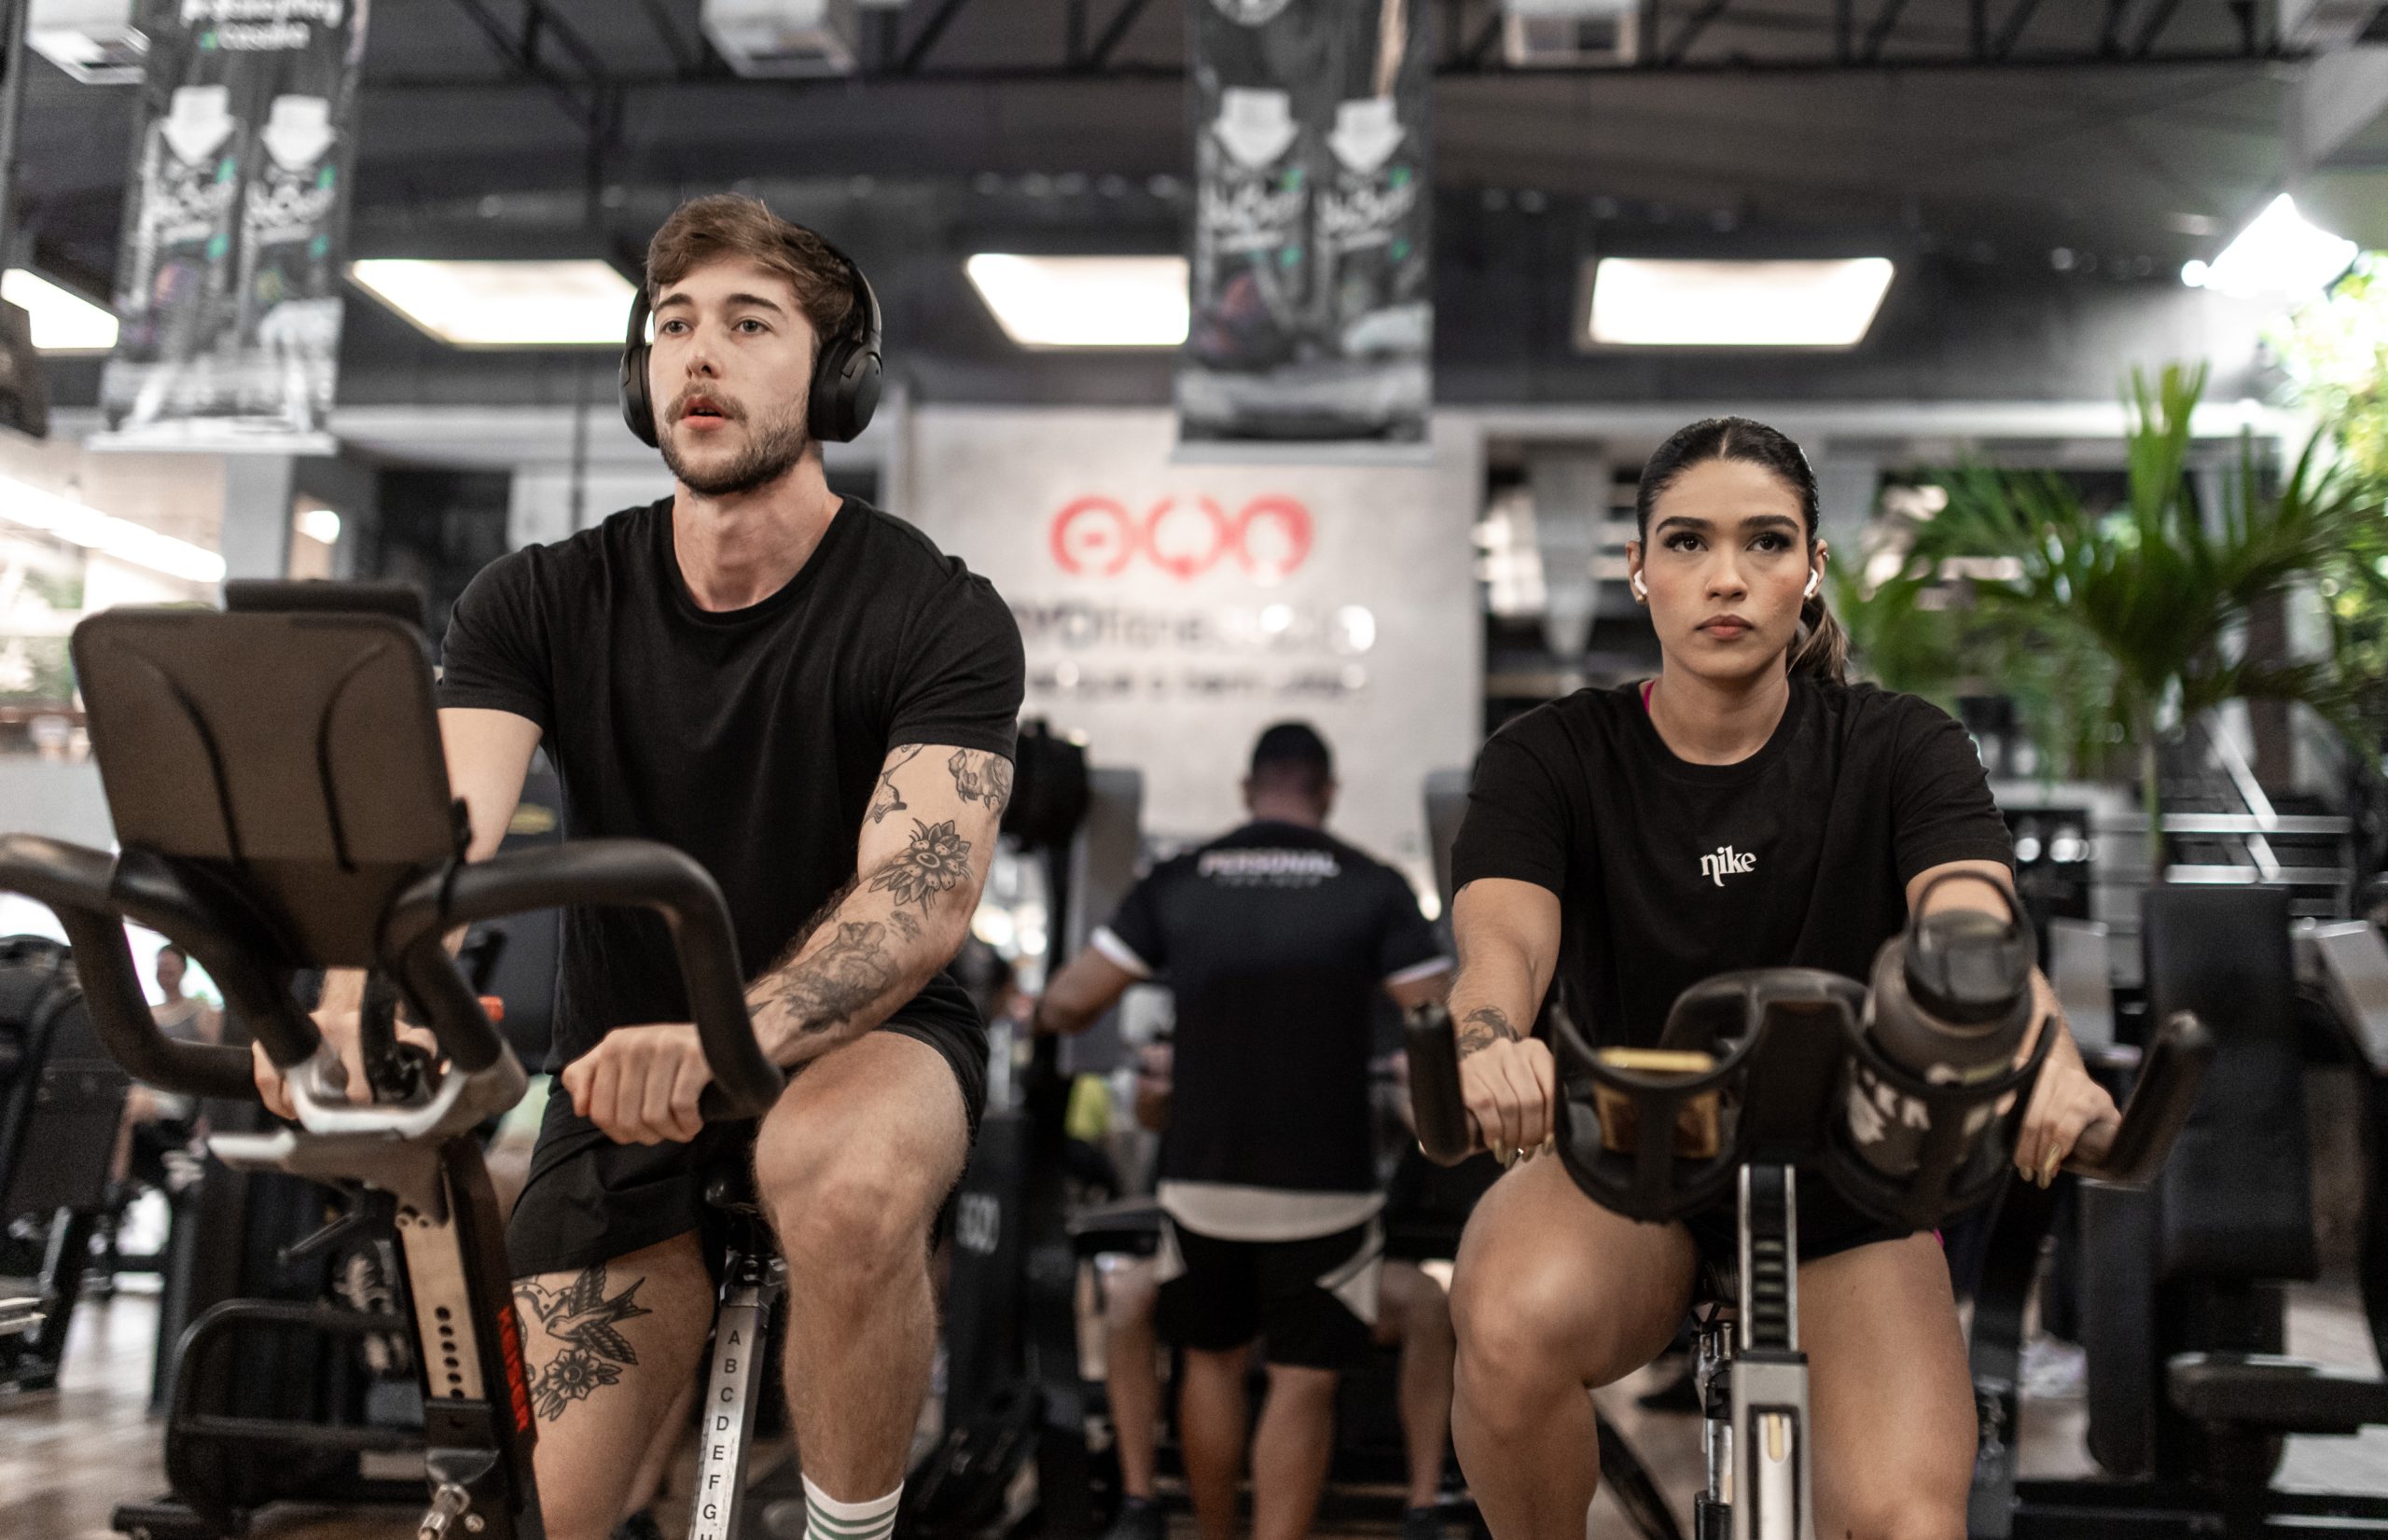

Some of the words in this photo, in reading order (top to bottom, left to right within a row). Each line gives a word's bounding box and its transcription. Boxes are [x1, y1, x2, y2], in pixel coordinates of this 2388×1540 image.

[1700, 845, 1756, 887] nike
[728, 1330, 741, 1346] A
[725, 1359, 737, 1374] B
[720, 1387, 734, 1403] C
[716, 1416, 729, 1431] D
[713, 1445, 725, 1461] E
[709, 1475, 721, 1490] F
[702, 1504, 716, 1519] G
